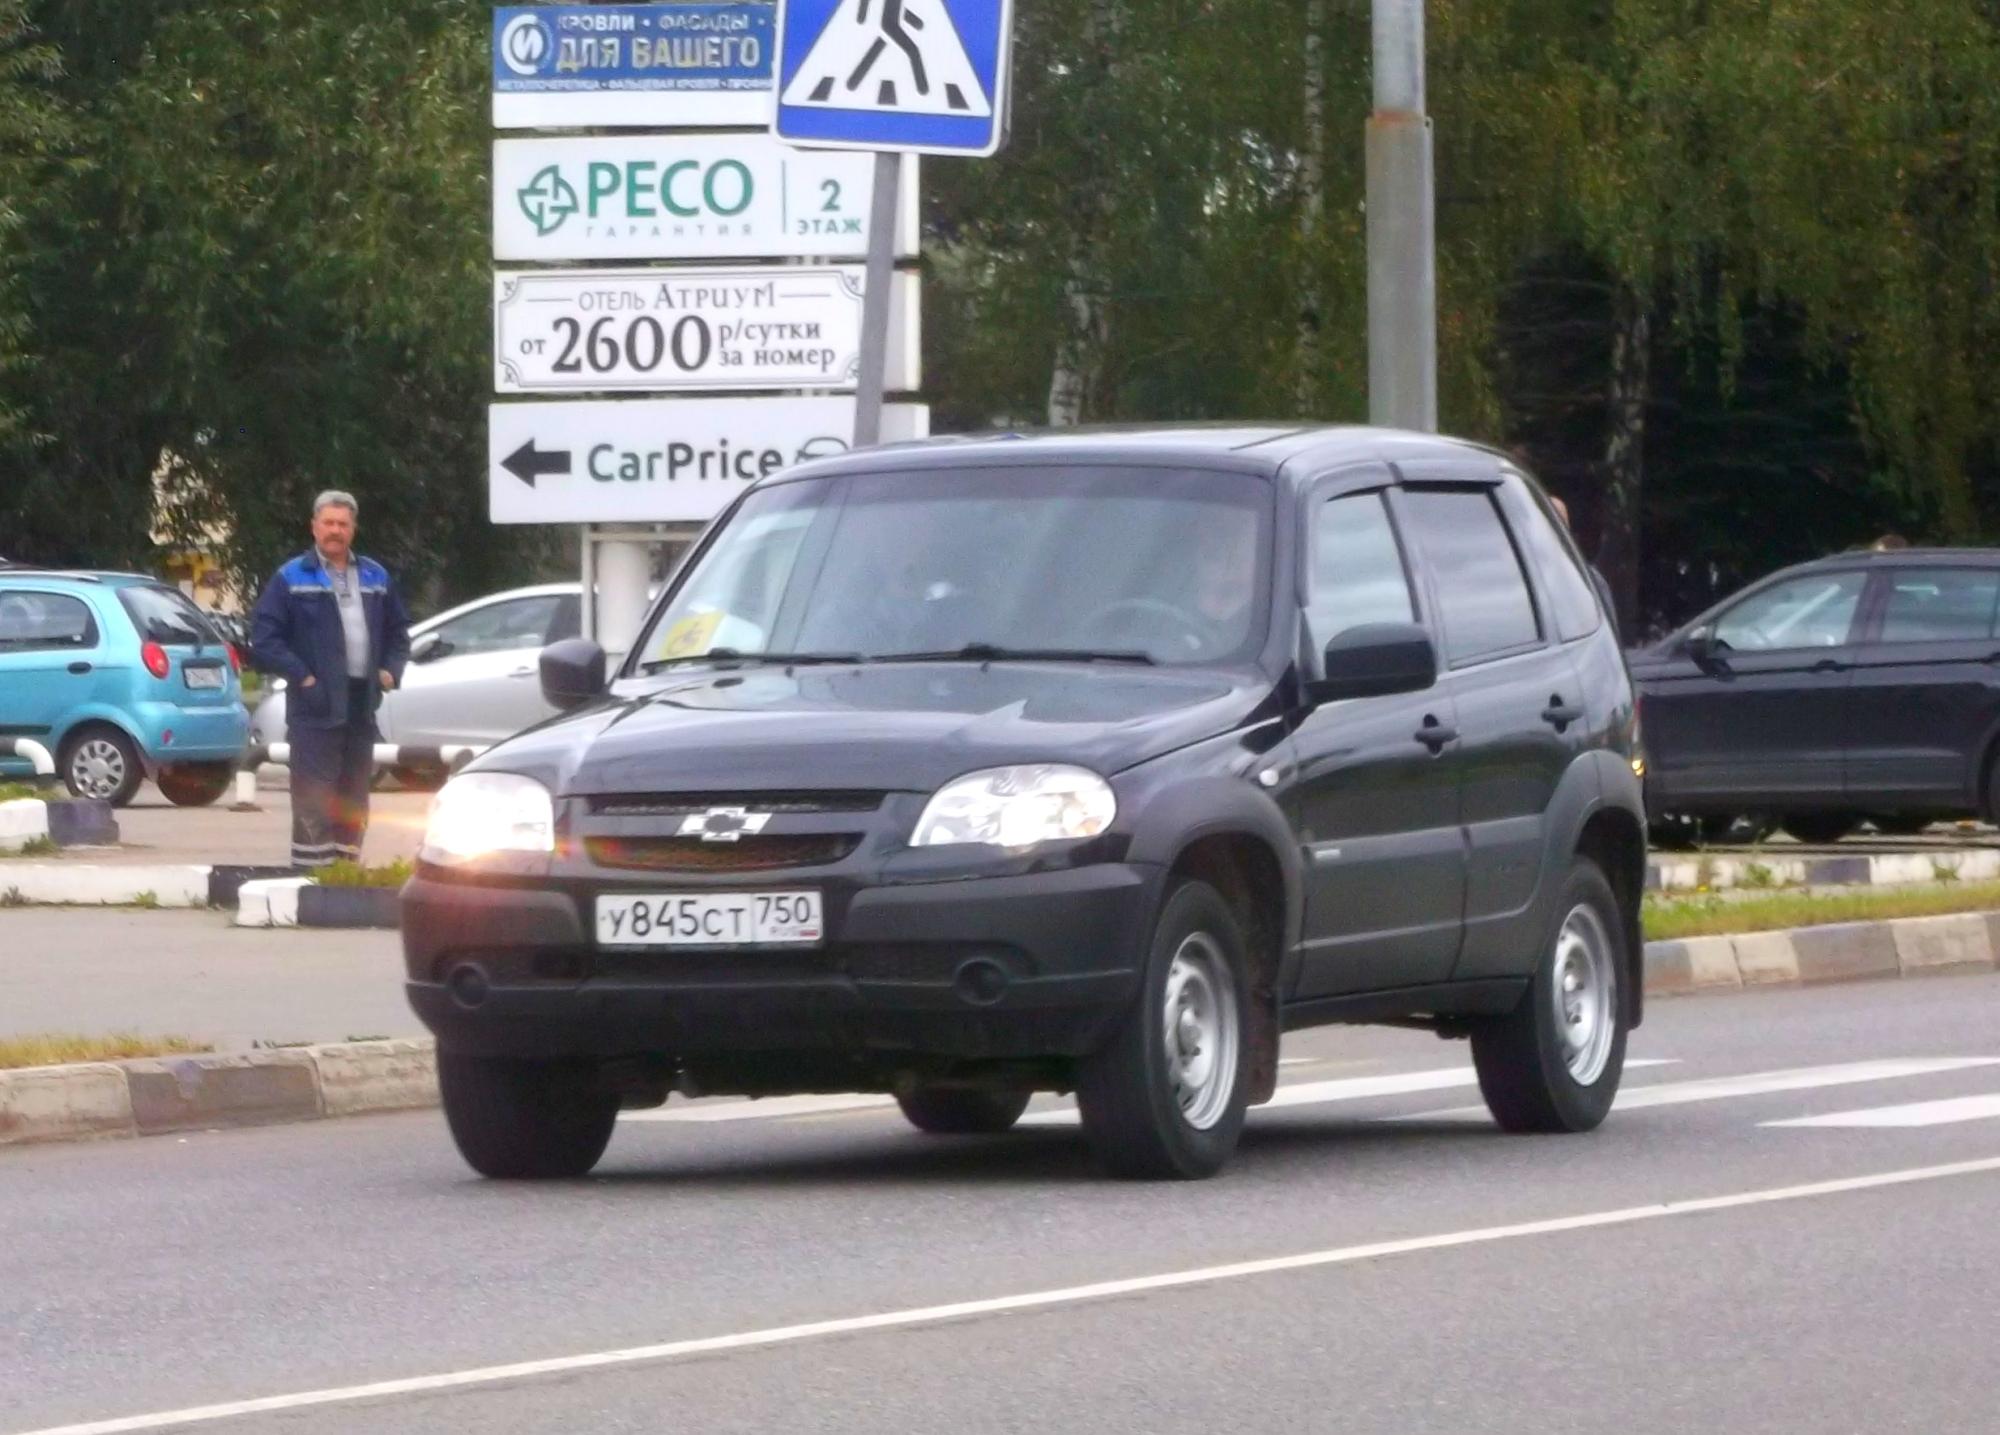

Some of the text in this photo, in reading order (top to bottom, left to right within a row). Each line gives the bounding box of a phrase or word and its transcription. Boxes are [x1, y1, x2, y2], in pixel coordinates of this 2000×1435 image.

[556, 36, 760, 72] ДЛЯ ВАШЕГО
[588, 159, 754, 218] РЕСО
[820, 178, 842, 212] 2
[586, 223, 753, 238] ГАРАНТИЯ
[797, 218, 863, 236] ЭТАЖ
[520, 314, 712, 373] от 2600
[718, 318, 822, 348] р/сутки
[718, 347, 836, 373] за номер
[587, 438, 784, 482] CarPrice
